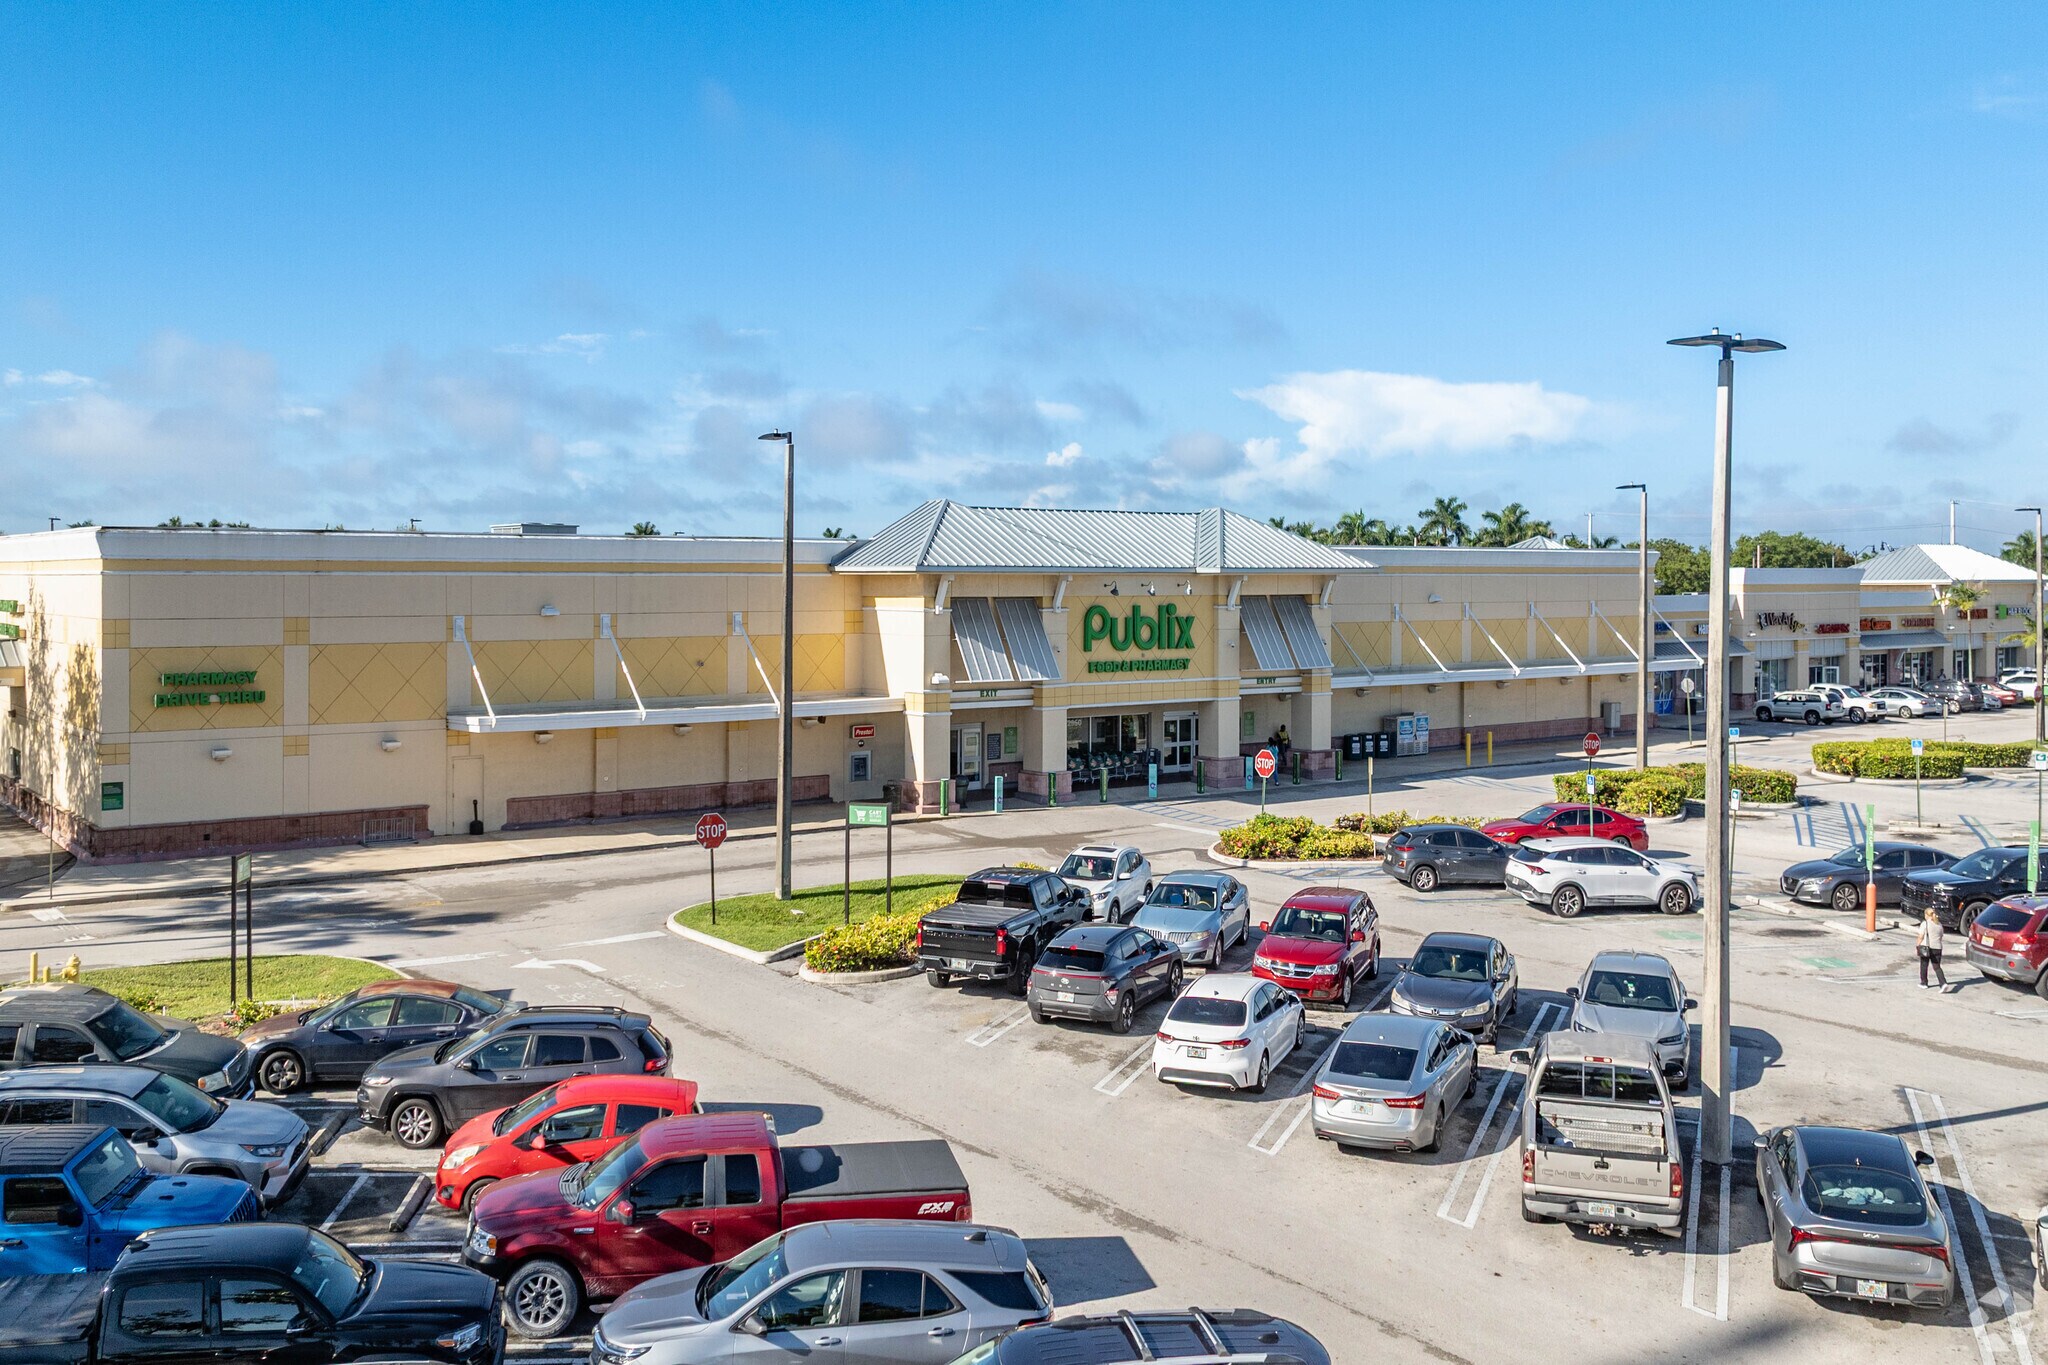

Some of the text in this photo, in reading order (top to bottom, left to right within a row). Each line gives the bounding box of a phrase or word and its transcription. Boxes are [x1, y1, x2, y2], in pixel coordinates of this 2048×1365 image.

[1083, 603, 1195, 652] Publix
[1088, 661, 1121, 674] FOOD
[1130, 658, 1191, 672] PHARMACY
[161, 671, 257, 687] PHARMACY
[1257, 677, 1277, 685] ENTRY
[154, 690, 266, 708] DRIVE THRU
[980, 689, 998, 698] EXIT
[855, 728, 874, 736] Presto!
[1584, 739, 1600, 750] STOP
[1256, 757, 1274, 770] STOP
[698, 823, 725, 839] STOP
[1541, 1168, 1663, 1187] CHEVROLET
